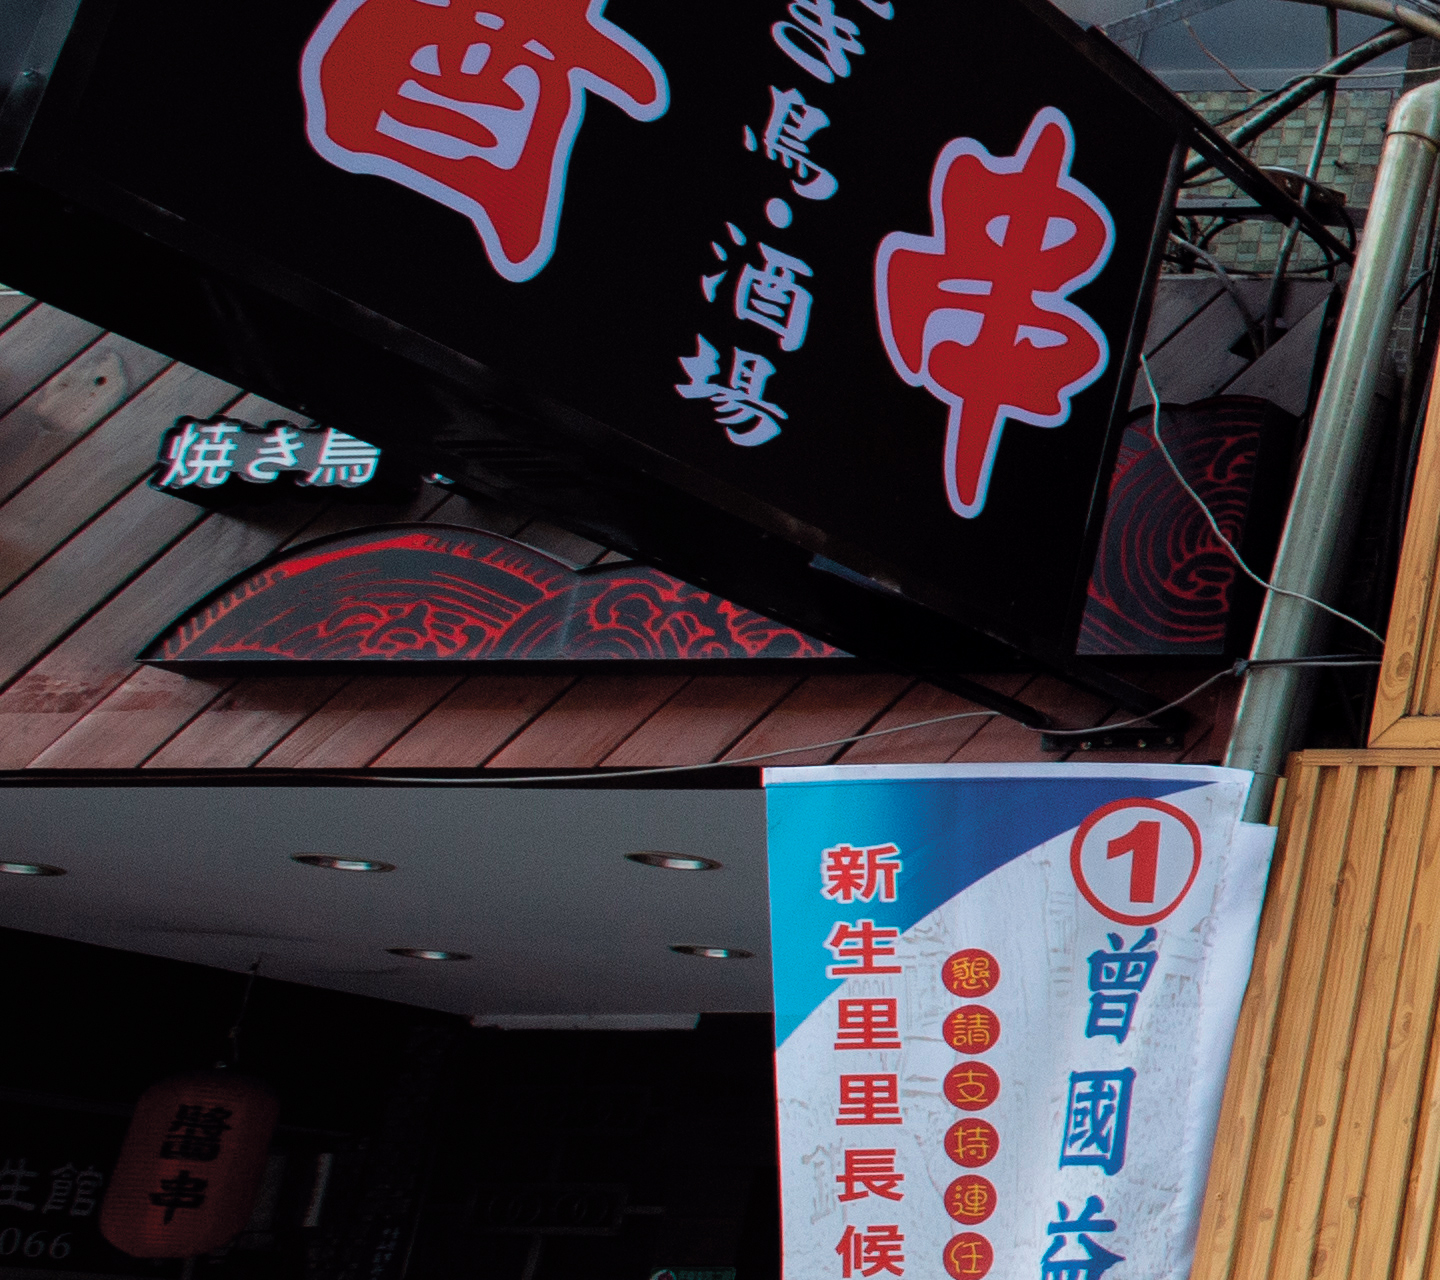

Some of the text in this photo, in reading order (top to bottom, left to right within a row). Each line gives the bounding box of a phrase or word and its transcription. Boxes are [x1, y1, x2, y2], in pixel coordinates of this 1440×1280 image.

[875, 107, 1117, 519] 串
[948, 956, 994, 1278] 懇請支持連任
